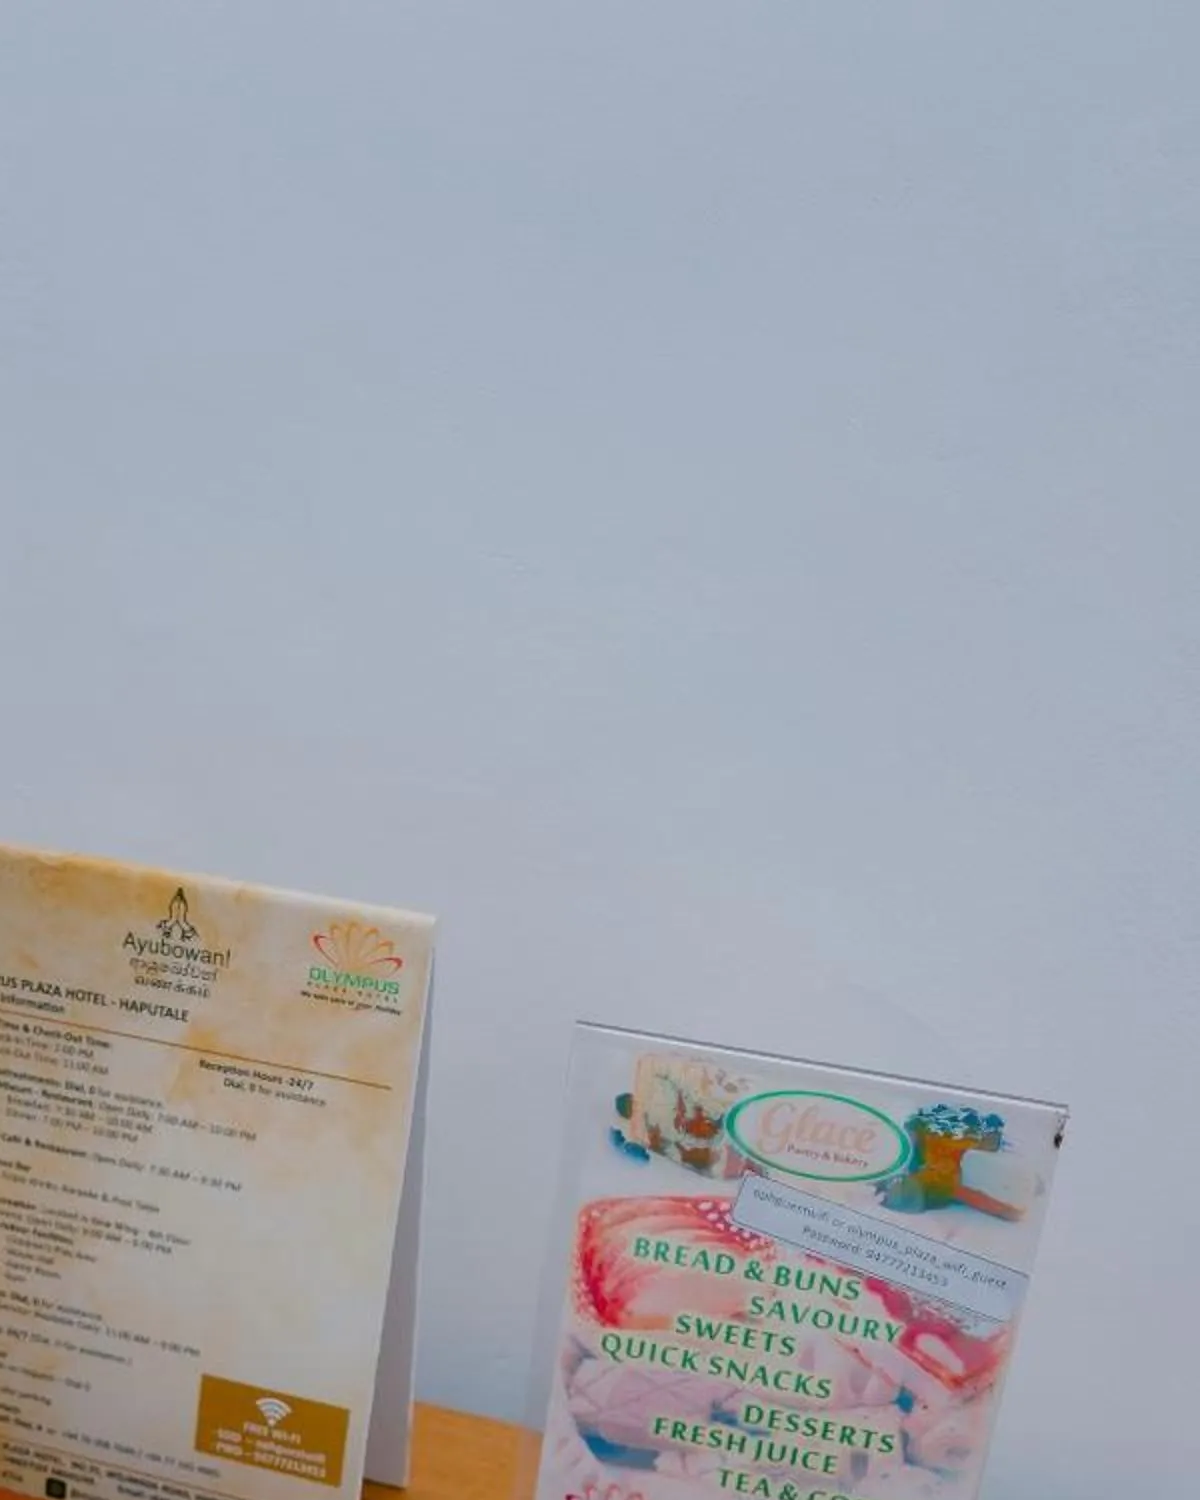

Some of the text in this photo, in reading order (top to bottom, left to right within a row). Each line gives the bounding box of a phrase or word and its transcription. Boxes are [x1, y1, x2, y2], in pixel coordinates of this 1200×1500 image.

[122, 931, 231, 969] Ayubowan!
[20, 978, 61, 998] PLAZA
[64, 986, 107, 1007] HOTEL
[118, 997, 189, 1022] HAPUTALE
[307, 964, 400, 995] OLYMPUS
[633, 1236, 862, 1301] BREAD & BUNS
[675, 1313, 798, 1357] SWEETS
[749, 1295, 903, 1344] SAVOURY
[600, 1331, 833, 1400] QUICK SNACKS
[653, 1416, 840, 1476] FRESH JUICE
[742, 1403, 896, 1454] DESSERTS
[718, 1468, 773, 1499] TEA
